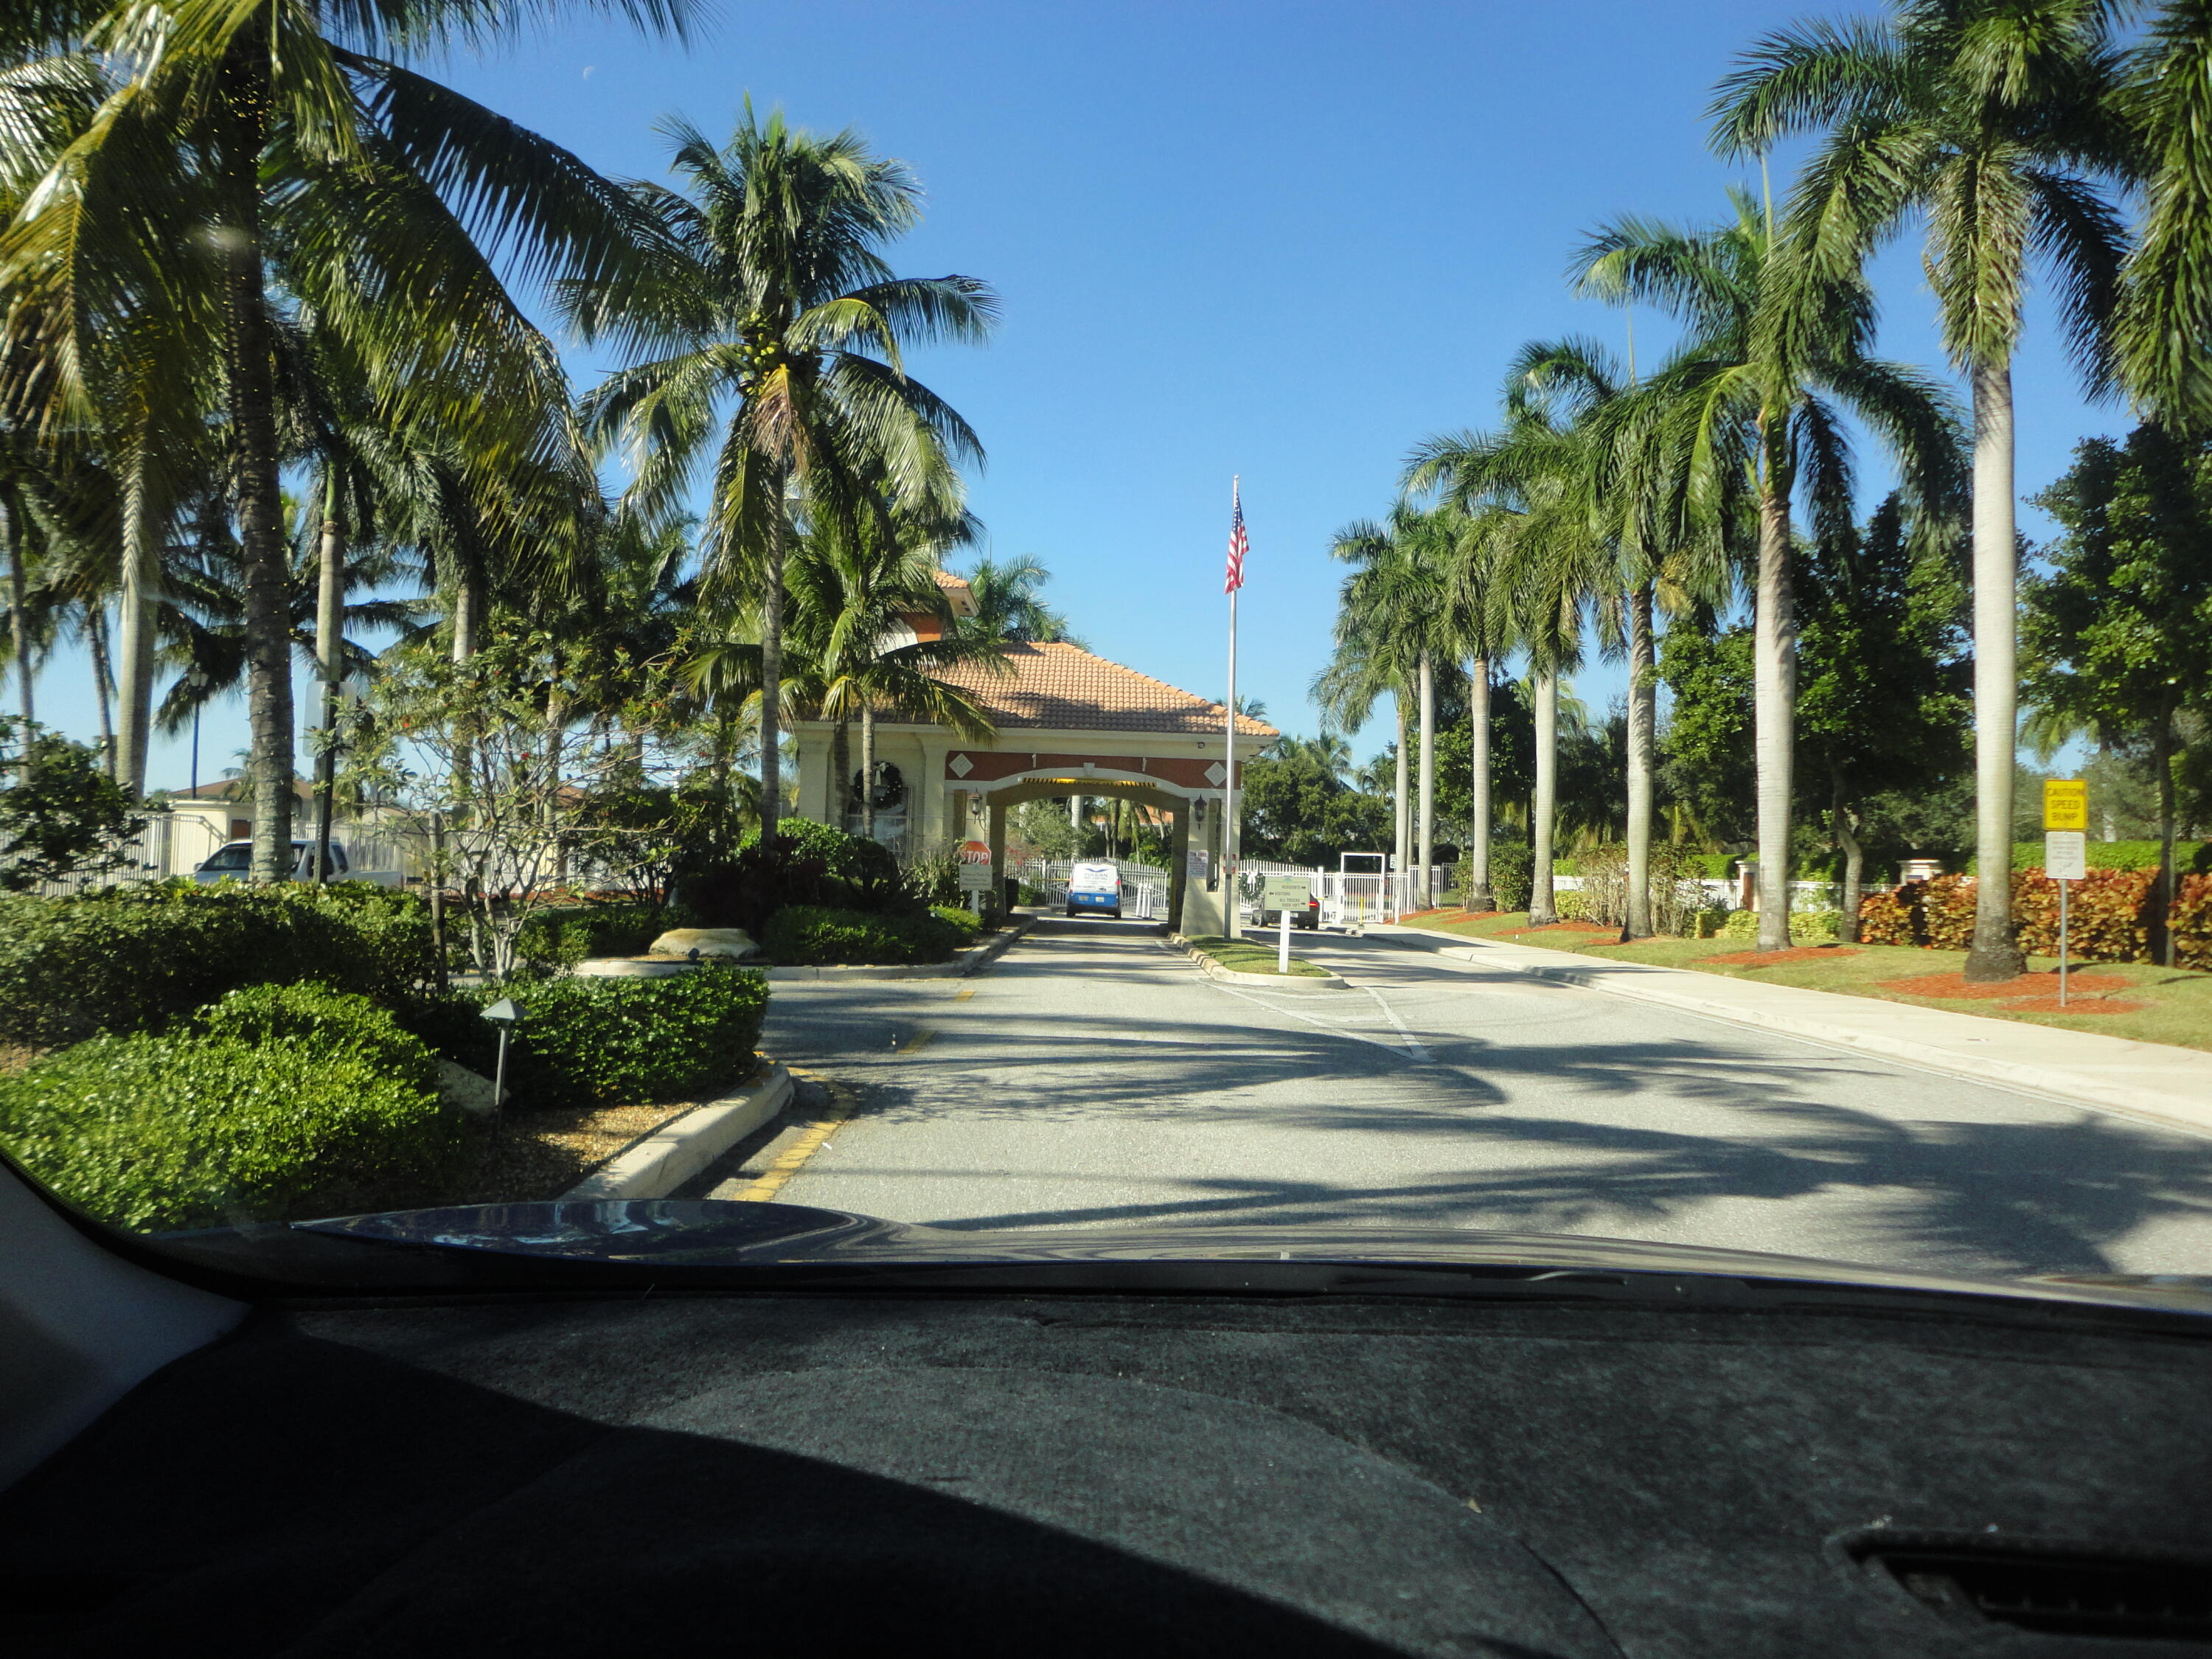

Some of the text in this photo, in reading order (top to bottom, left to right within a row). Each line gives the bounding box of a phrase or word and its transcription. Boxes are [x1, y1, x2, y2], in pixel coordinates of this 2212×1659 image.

[2045, 787, 2085, 797] CAUTION
[2051, 800, 2081, 810] SPEED
[2051, 812, 2079, 821] BUMP
[961, 850, 989, 864] TOP
